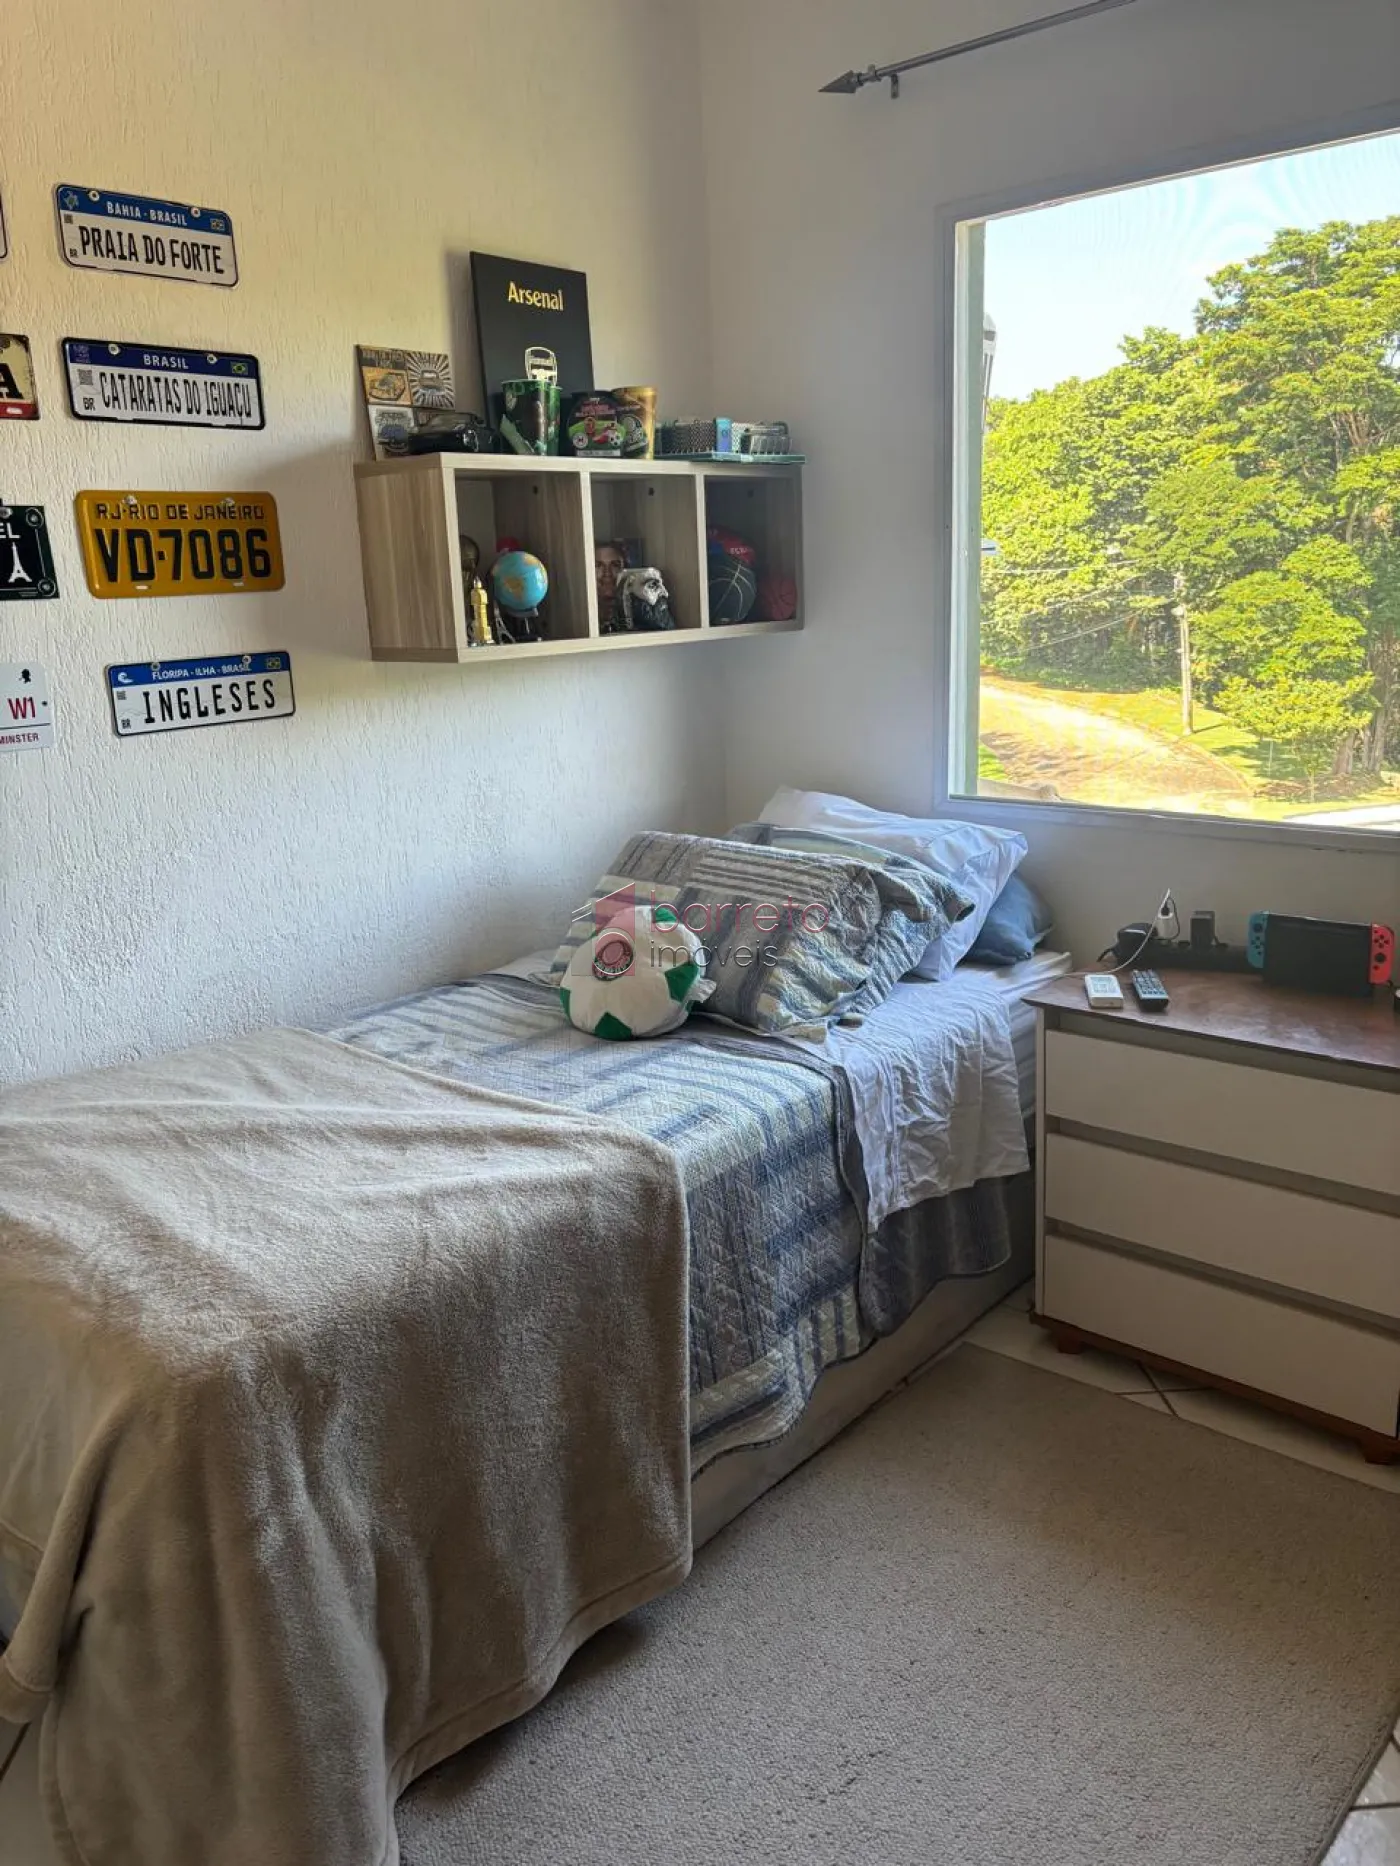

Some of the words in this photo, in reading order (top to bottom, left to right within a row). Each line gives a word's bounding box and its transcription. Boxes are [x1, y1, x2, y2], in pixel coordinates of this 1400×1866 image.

[106, 201, 141, 218] BAHIA
[150, 209, 187, 226] BRASIL
[79, 225, 139, 262] PRAIA
[142, 235, 166, 266] DO
[169, 238, 225, 274] FORTE
[508, 281, 564, 311] Arsenal
[143, 354, 188, 370] BRASIL
[83, 397, 95, 411] BR
[100, 372, 182, 414] CATARATAS
[184, 378, 201, 415] DO
[166, 504, 188, 520] DE
[194, 504, 264, 520] JANEIRO
[152, 668, 189, 681] FLORIPA
[195, 666, 216, 676] ILHA
[7, 697, 36, 720] W1
[143, 679, 275, 723] INGLESES
